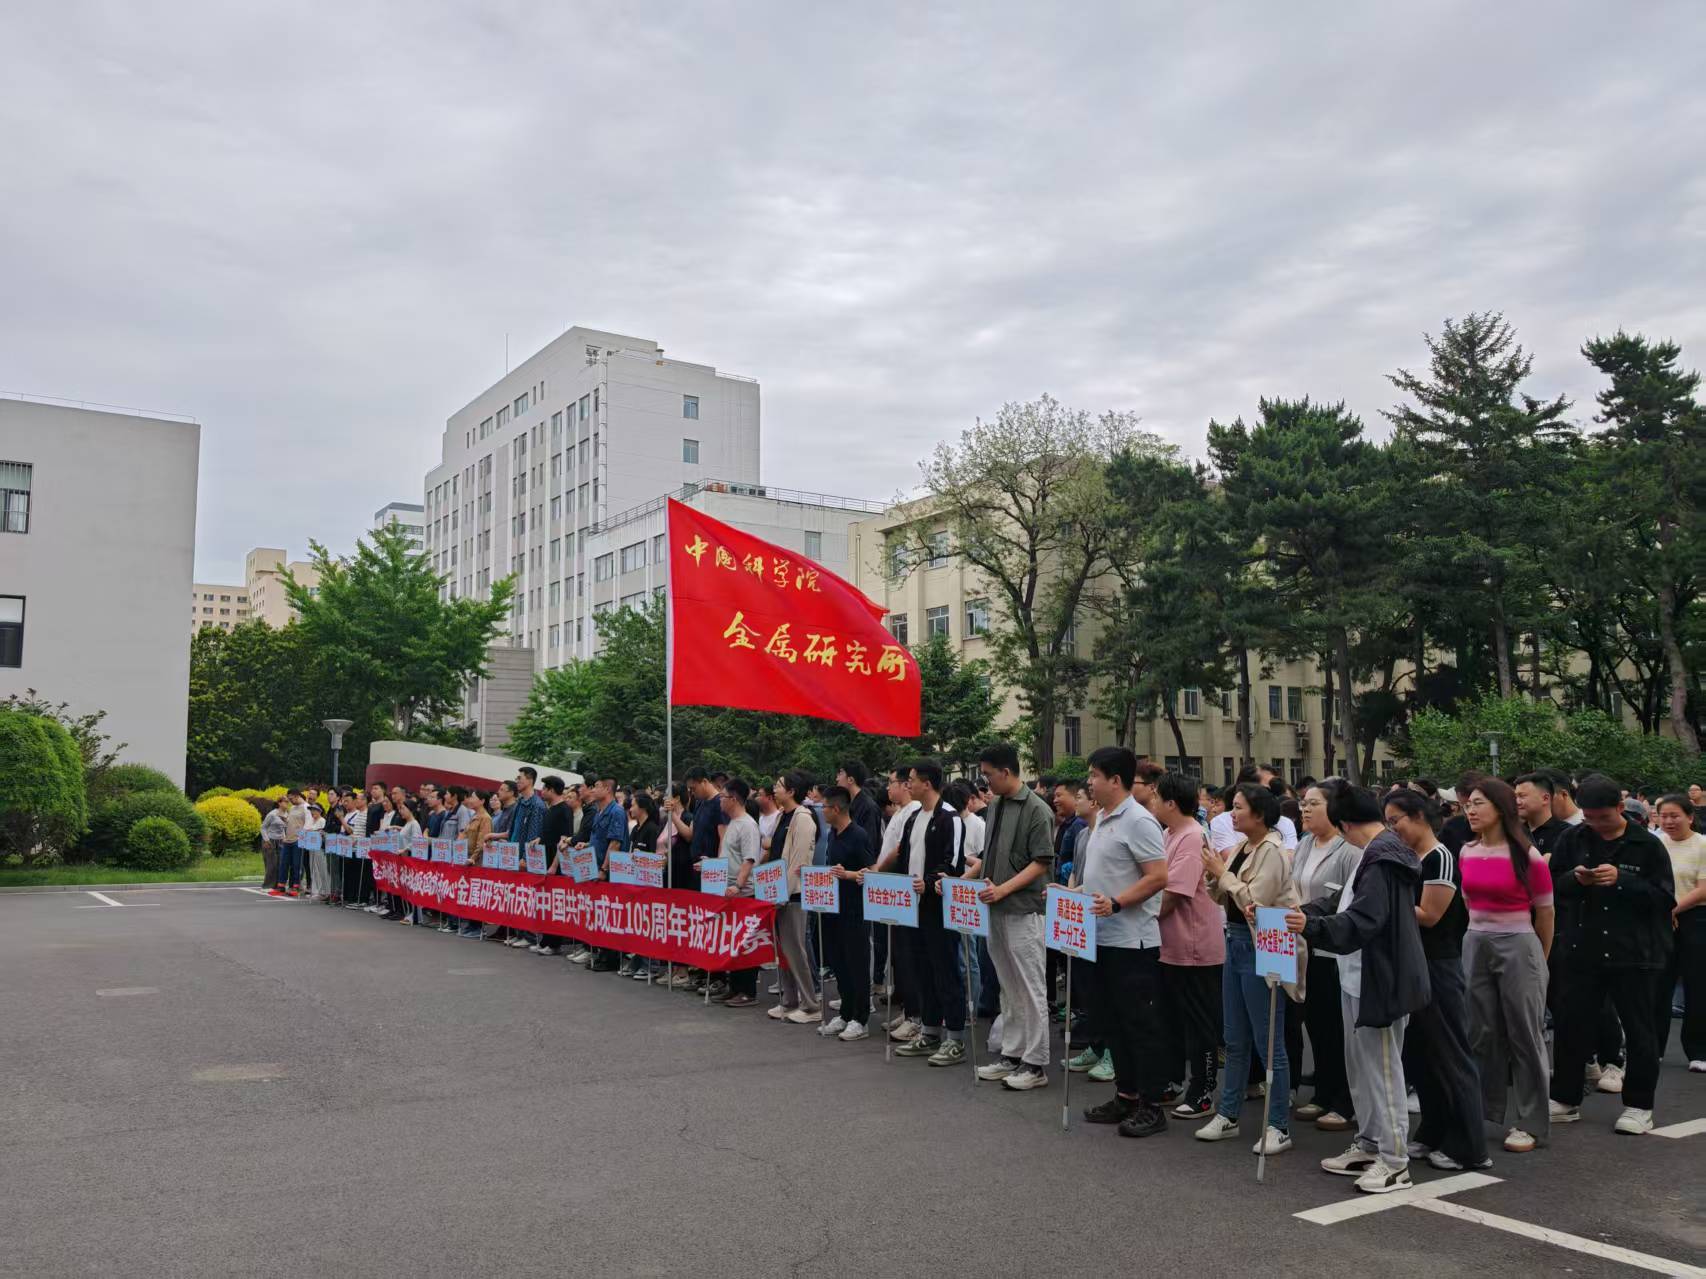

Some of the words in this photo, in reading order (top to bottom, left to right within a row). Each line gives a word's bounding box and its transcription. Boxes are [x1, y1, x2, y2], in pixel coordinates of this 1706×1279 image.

[684, 534, 822, 592] 中国科学院
[723, 611, 911, 681] 金属研究所
[868, 886, 912, 907] 钛合金分工会
[952, 883, 977, 906] 高温合金
[950, 905, 981, 928] 第二分工会
[1057, 896, 1084, 923] 高温合金
[1053, 919, 1087, 949] 第一分工会
